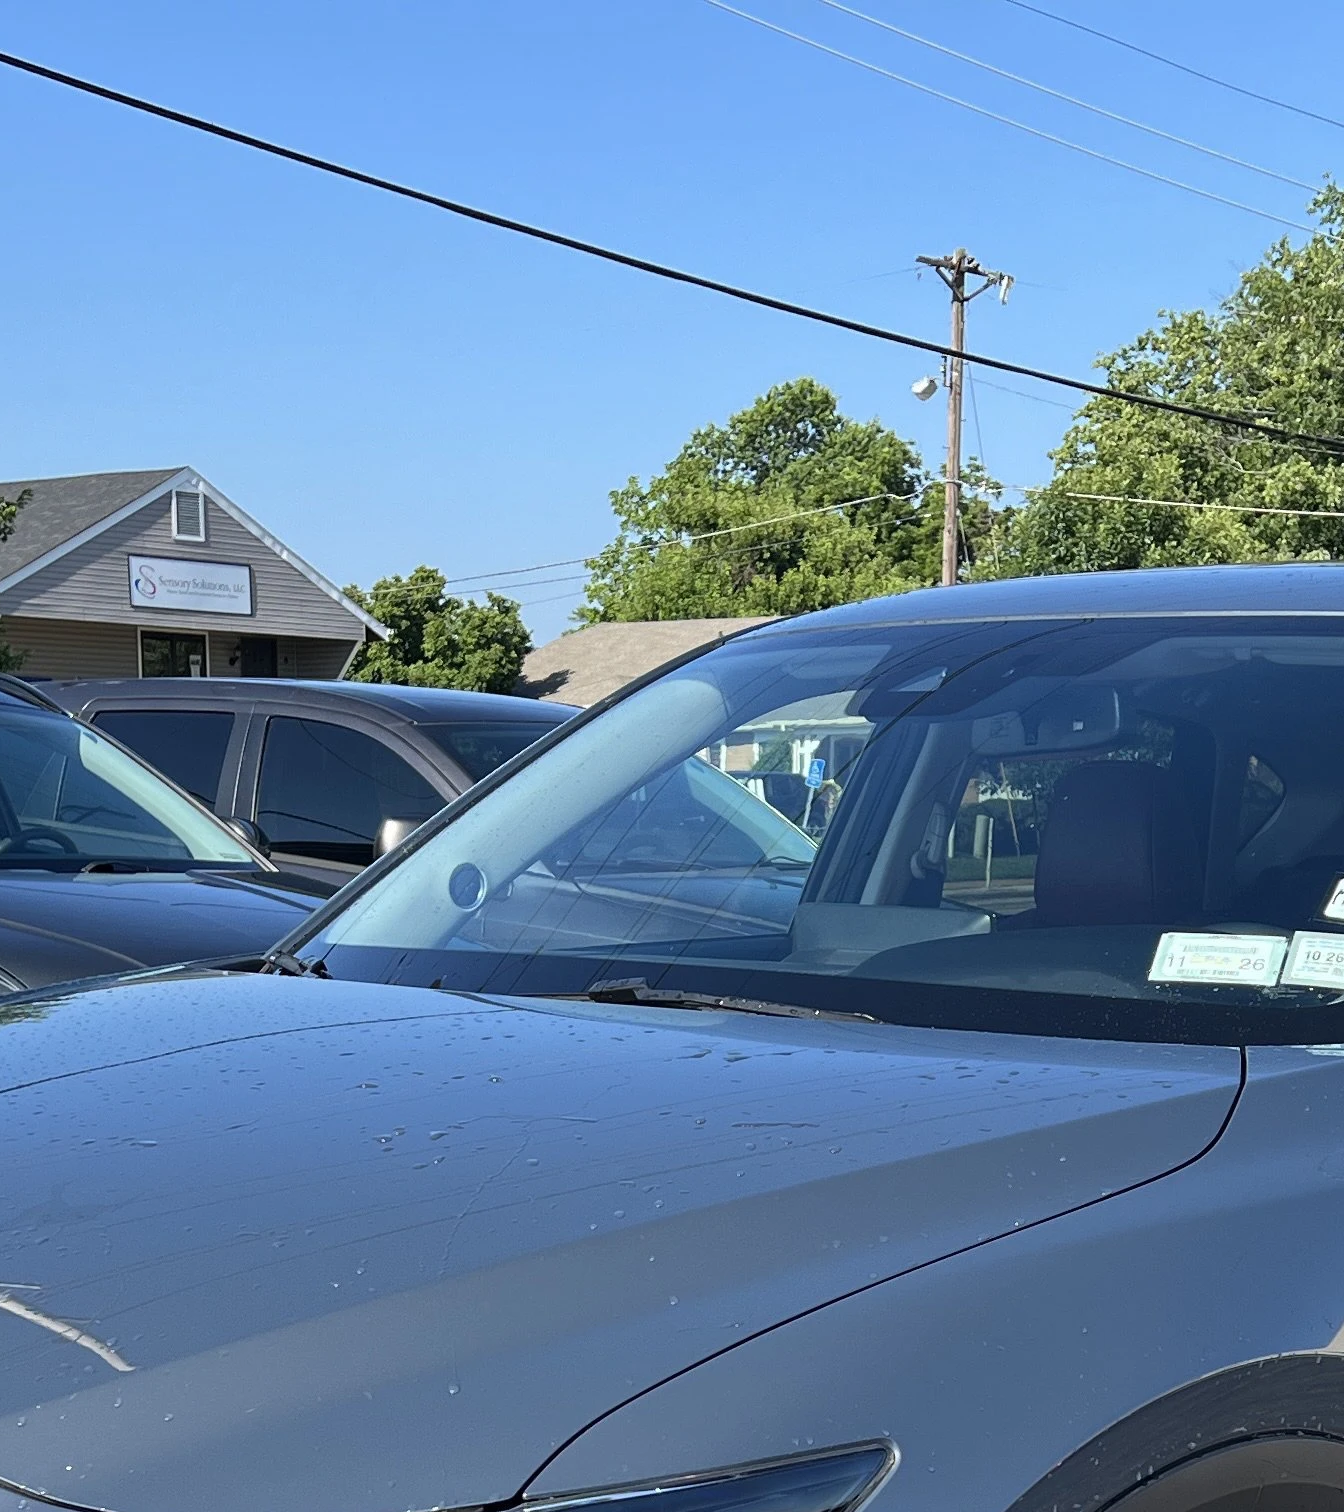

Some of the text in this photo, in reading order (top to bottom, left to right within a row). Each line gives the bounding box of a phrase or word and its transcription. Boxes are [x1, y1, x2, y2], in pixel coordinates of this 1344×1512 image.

[158, 575, 191, 592] Sensory
[1167, 954, 1266, 971] 11 26
[1305, 950, 1344, 963] 10 26
